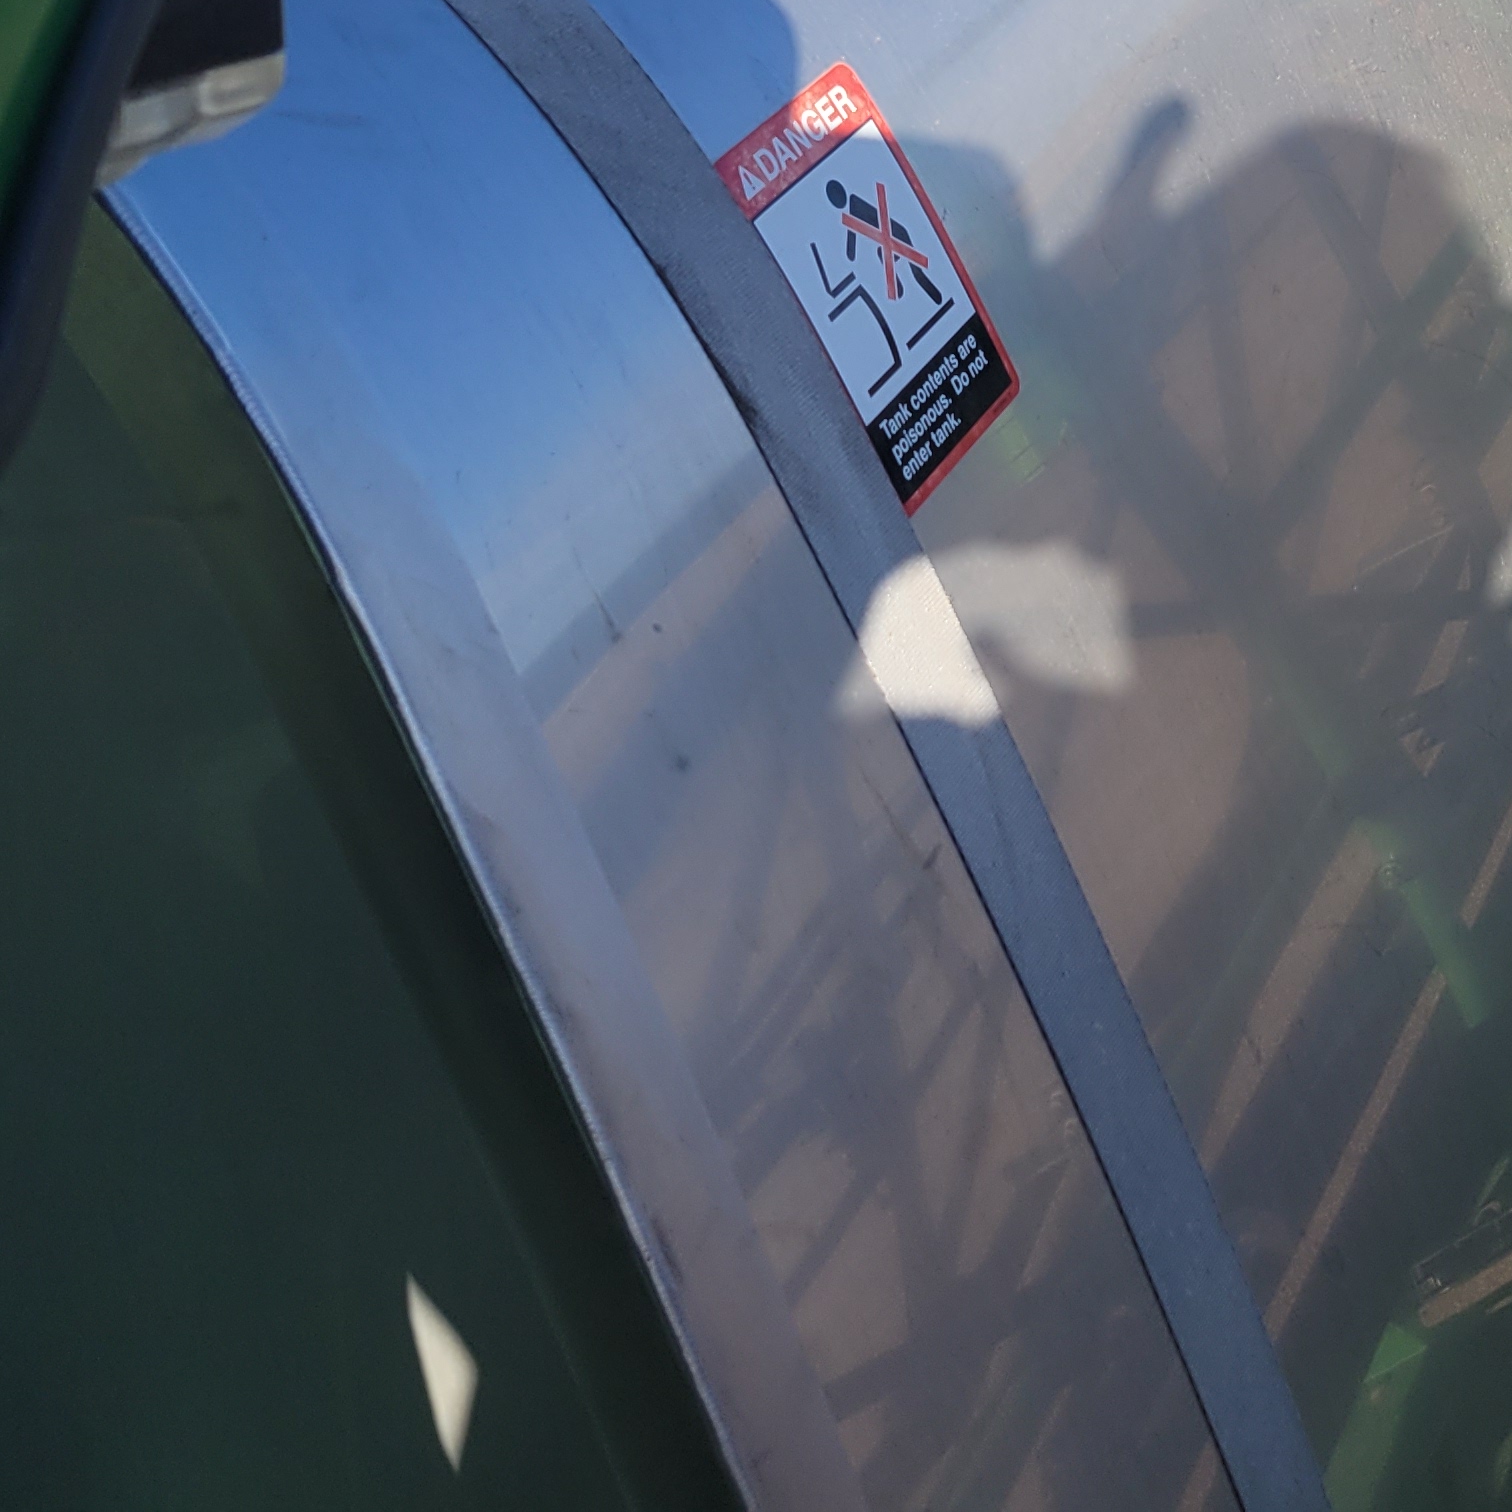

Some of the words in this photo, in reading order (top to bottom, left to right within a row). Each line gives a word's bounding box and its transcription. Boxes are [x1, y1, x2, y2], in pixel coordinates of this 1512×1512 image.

[754, 84, 858, 178] DANGER
[879, 403, 912, 439] Tank
[910, 353, 959, 410] contents
[957, 334, 977, 360] are
[891, 393, 953, 465] poisonous.
[950, 371, 970, 395] Do
[968, 349, 989, 378] not
[902, 440, 933, 481] enter
[930, 412, 962, 447] tank.
